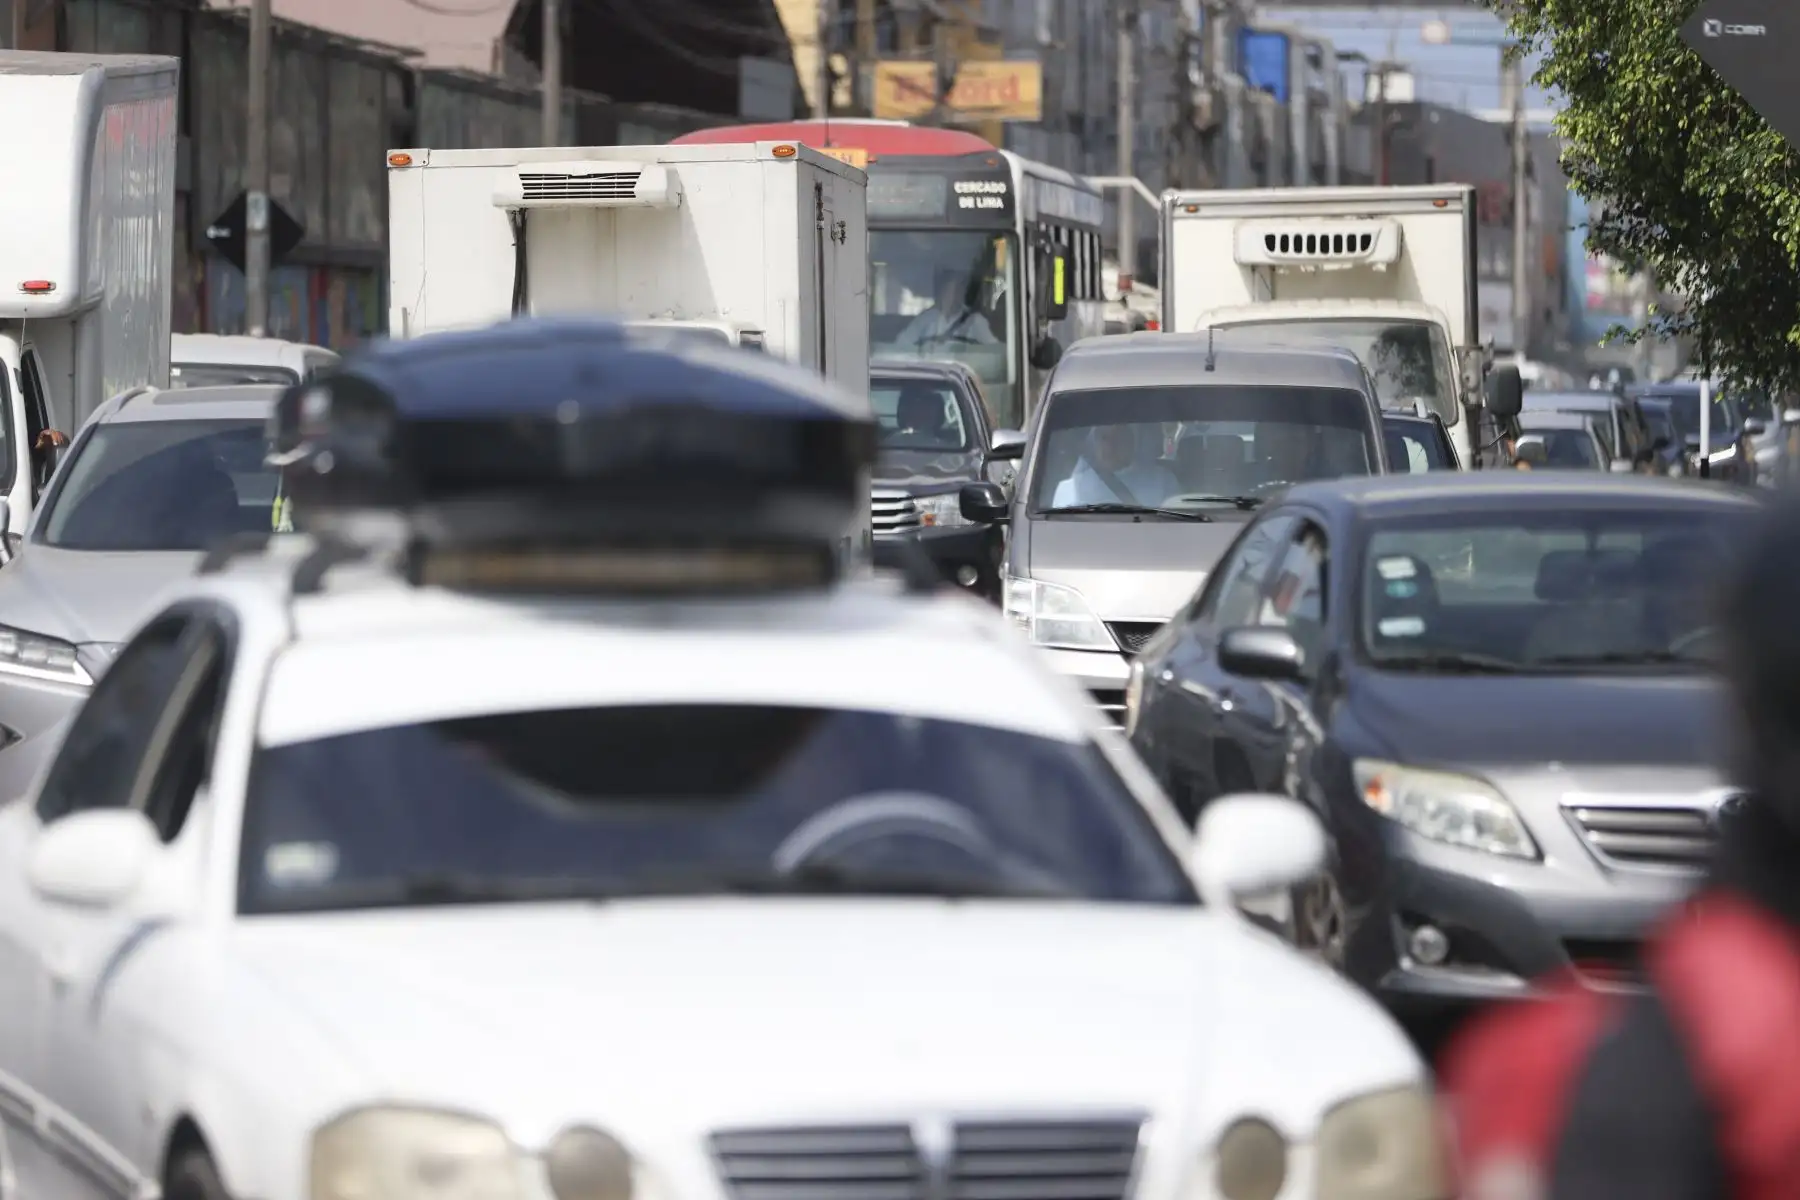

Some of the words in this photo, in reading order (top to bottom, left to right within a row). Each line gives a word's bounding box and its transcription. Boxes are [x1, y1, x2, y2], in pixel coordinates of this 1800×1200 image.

[954, 181, 1007, 194] CERCADO
[958, 196, 975, 209] DE
[976, 196, 1005, 209] LIMA
